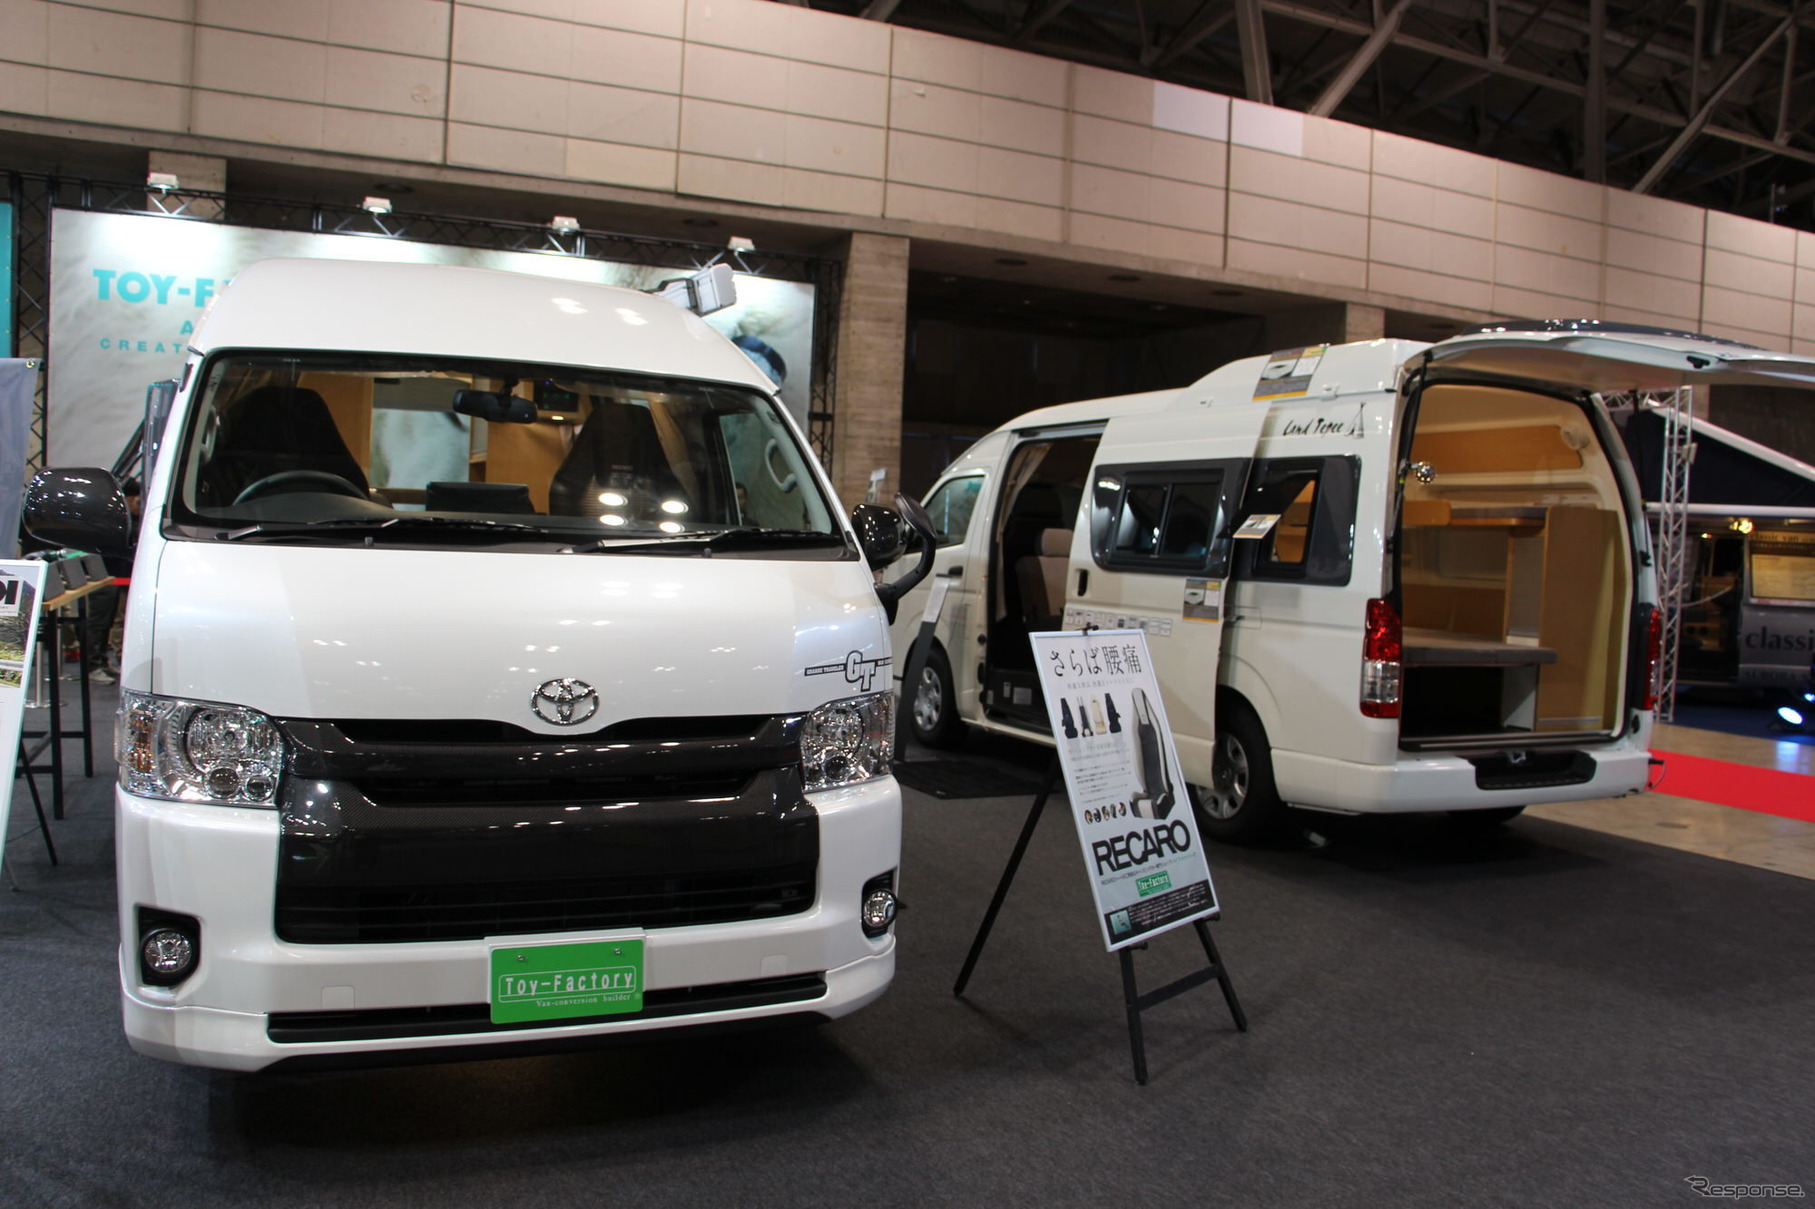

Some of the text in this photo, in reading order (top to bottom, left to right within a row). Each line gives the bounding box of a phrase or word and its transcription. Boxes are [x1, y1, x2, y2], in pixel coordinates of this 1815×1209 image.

[93, 268, 231, 308] TOY-F
[1283, 420, 1313, 436] Land
[845, 650, 877, 692] GT
[1049, 643, 1142, 677] さらば腰痛
[1092, 819, 1191, 876] RECARO
[505, 972, 633, 996] Toy-Factory
[536, 994, 631, 1007] Van-conversion builder
